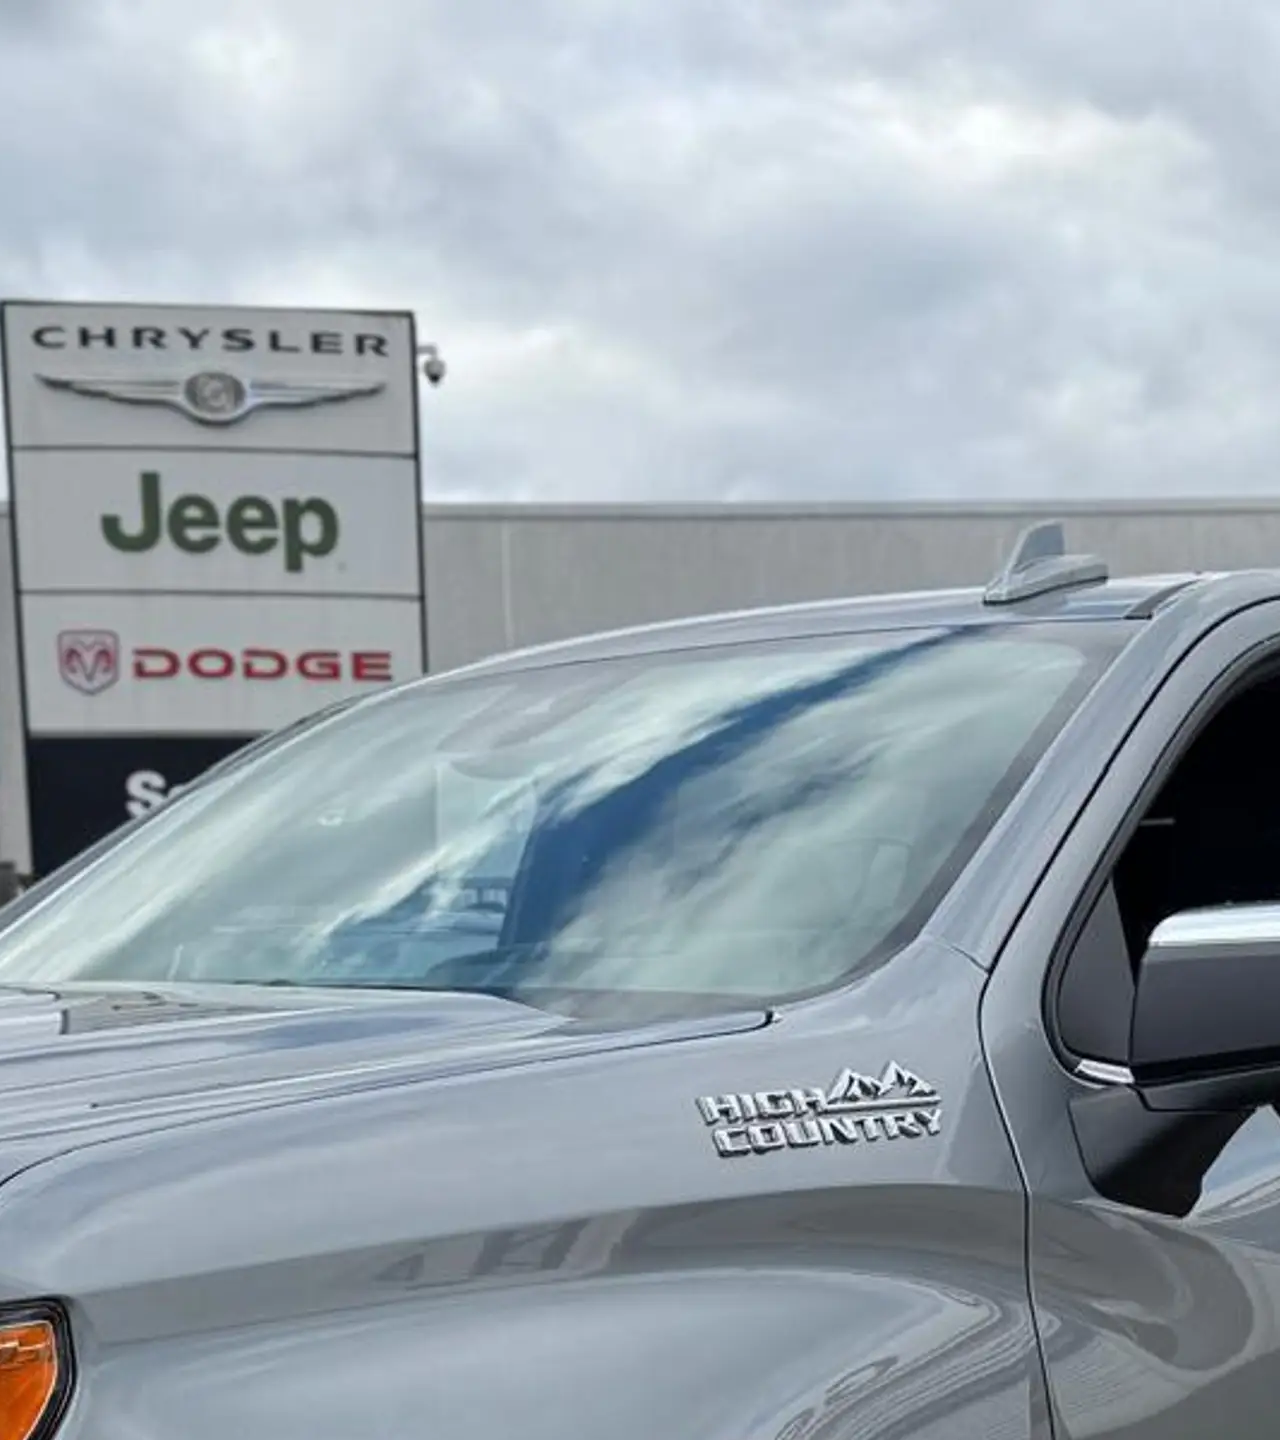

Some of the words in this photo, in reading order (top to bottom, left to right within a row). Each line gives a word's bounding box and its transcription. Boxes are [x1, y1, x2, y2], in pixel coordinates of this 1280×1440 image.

[31, 325, 389, 358] CHRYSLER
[101, 471, 339, 573] Jeep
[132, 647, 393, 682] DODGE
[696, 1087, 827, 1126] HIGH
[712, 1108, 943, 1157] COUNTRY
